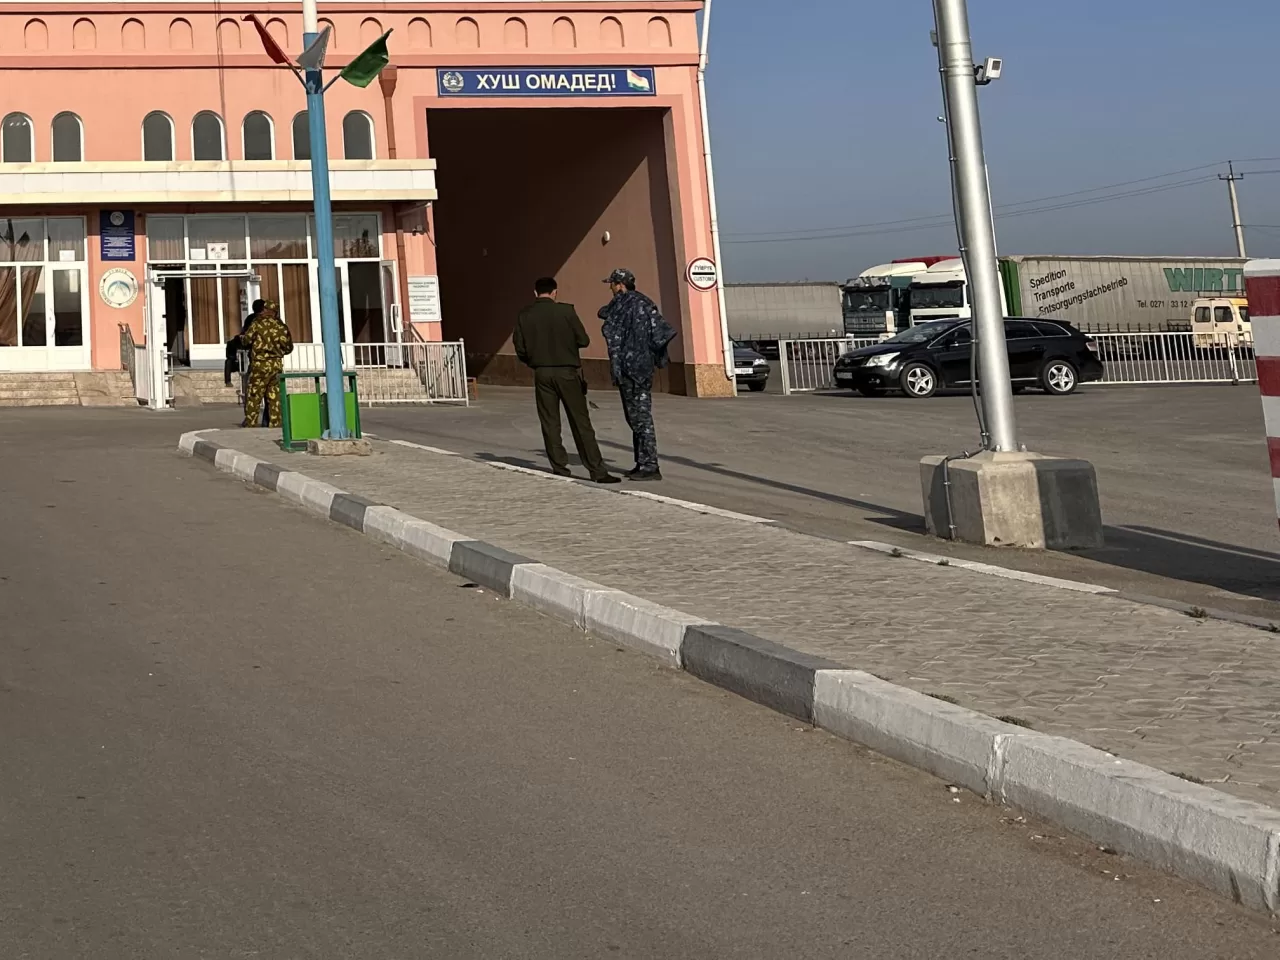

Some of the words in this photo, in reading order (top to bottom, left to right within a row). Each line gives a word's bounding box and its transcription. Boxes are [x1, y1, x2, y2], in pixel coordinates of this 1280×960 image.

[476, 74, 520, 90] ХУШ
[525, 73, 617, 92] ОМАДЕД!
[1029, 269, 1067, 289] Spedition
[1163, 267, 1245, 292] WIRT
[1033, 281, 1076, 303] Transporte
[1137, 300, 1148, 308] Tel.
[1149, 300, 1165, 308] 0271
[1170, 300, 1179, 308] 33
[1180, 300, 1188, 308] 12
